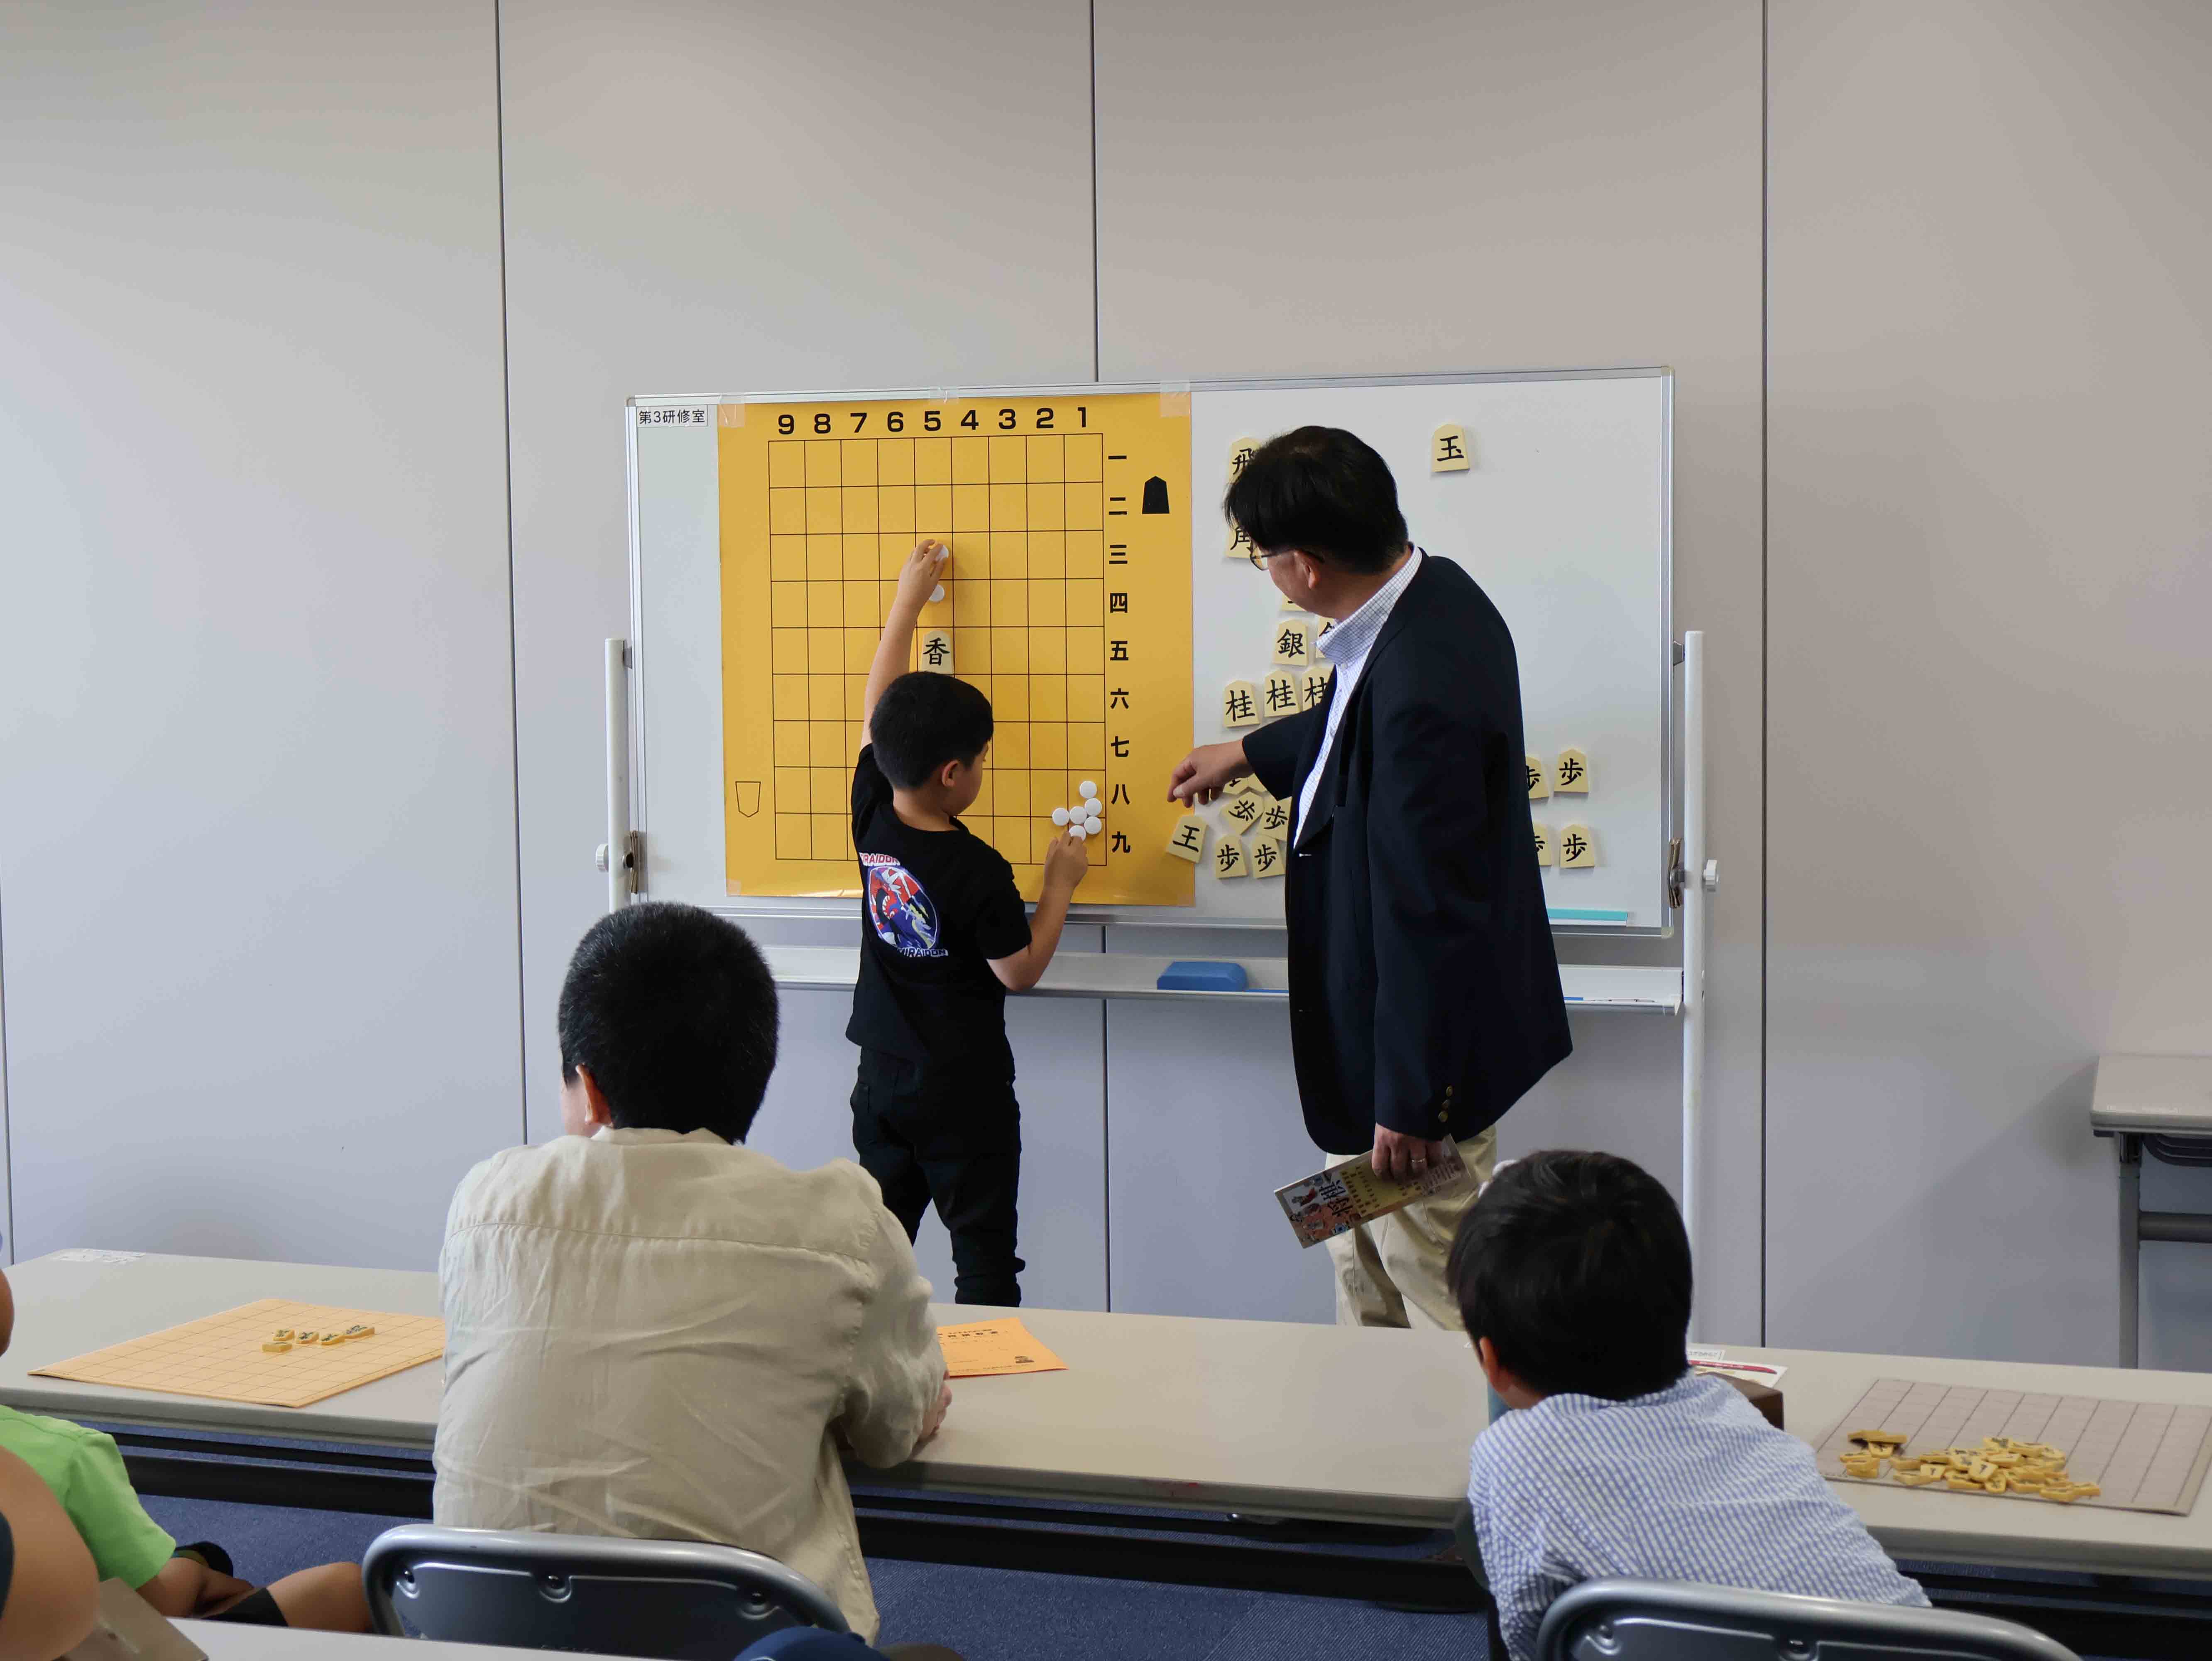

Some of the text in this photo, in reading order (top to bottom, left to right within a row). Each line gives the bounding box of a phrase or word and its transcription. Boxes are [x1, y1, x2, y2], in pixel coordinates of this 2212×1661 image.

[639, 409, 705, 424] 第3研修室
[778, 407, 1086, 435] 9 8 7 6 5 4 3 2 1
[1437, 436, 1464, 462] 玉
[1108, 497, 1128, 515] 二
[1109, 544, 1128, 564] 三
[1110, 593, 1128, 613] 四
[923, 637, 950, 666] 香
[1110, 641, 1129, 661] 五
[1277, 629, 1305, 658] 銀
[1110, 688, 1129, 709] 六
[1225, 690, 1255, 722] 桂
[1266, 679, 1296, 711] 桂
[1111, 736, 1130, 757] 七
[1559, 758, 1583, 786] 歩
[1111, 784, 1130, 805] 八
[1228, 800, 1255, 821] 歩
[1264, 805, 1288, 830] 歩
[1111, 831, 1131, 853] 九
[1172, 825, 1200, 853] 王
[1563, 833, 1587, 862] 歩
[1217, 844, 1240, 872] 歩
[1254, 844, 1277, 872] 歩
